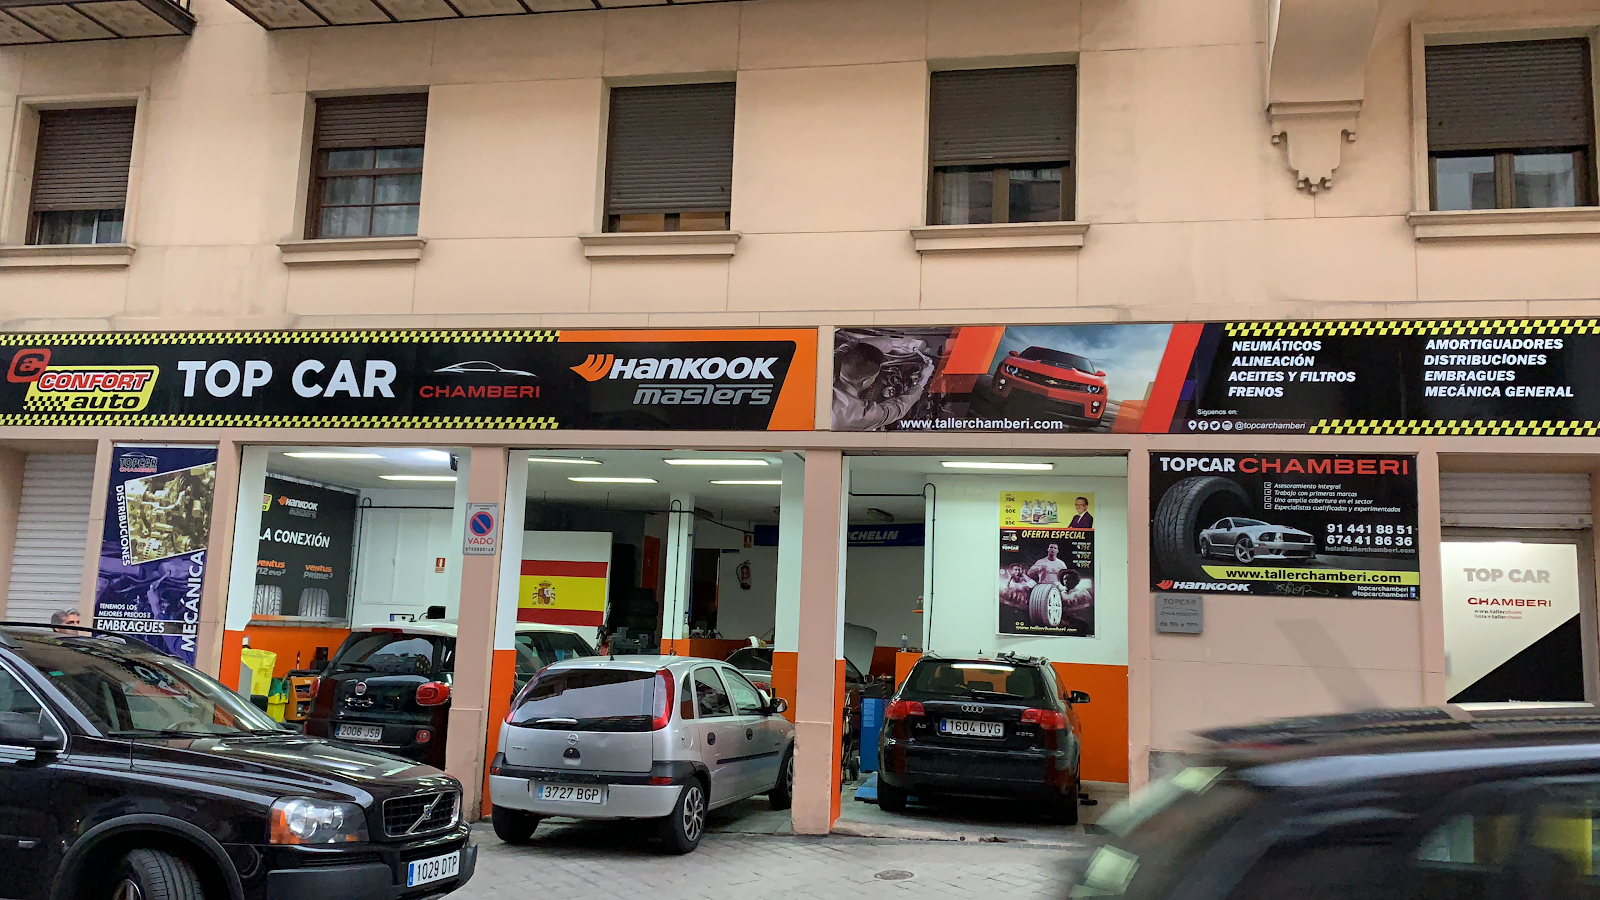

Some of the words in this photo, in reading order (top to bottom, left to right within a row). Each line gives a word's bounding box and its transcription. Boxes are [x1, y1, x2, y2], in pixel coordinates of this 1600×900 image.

[1231, 339, 1322, 352] NEUMÁTICOS
[1425, 338, 1564, 351] AMORTIGUADORES
[1232, 354, 1315, 367] ALINEACIÓN
[1423, 353, 1547, 366] DISTRIBUCIONES
[39, 372, 151, 391] CONFORT
[177, 359, 274, 398] TOP
[291, 359, 398, 398] CAR
[1228, 371, 1284, 383] ACEITES
[1288, 371, 1296, 382] Y
[1299, 371, 1357, 383] FILTROS
[1424, 370, 1516, 382] EMBRAGUES
[419, 385, 541, 399] CHAMBERI
[1228, 386, 1284, 398] FRENOS
[1424, 383, 1502, 398] MECÁNICA
[1504, 385, 1575, 398] GENERAL
[71, 394, 141, 409] auto
[900, 416, 1064, 431] www.tallerchamberi.com
[1234, 421, 1307, 430] @topcarchamberi
[1159, 456, 1236, 473] TOPCAR
[1238, 457, 1410, 475] CHAMBERI
[1274, 489, 1297, 497] Trabajo
[1309, 490, 1336, 498] primeras
[1353, 505, 1401, 513] experimentados
[115, 484, 131, 566] DISTRIBUCIONES
[1326, 523, 1343, 533] 91
[1347, 523, 1372, 534] 441
[1375, 524, 1394, 535] 88
[1396, 525, 1413, 535] 51
[274, 529, 331, 549] CONEXIÓN
[467, 537, 494, 545] VADO
[1021, 530, 1050, 539] OFERTA
[1051, 531, 1086, 540] ESPECIAL
[1326, 534, 1352, 545] 674
[1355, 535, 1371, 545] 41
[1375, 536, 1393, 546] 86
[1395, 537, 1413, 547] 36
[1325, 546, 1416, 554] hola@tallerchamberi.com
[1226, 569, 1402, 583] www.tallerchamberi.com
[1463, 568, 1504, 582] TOP
[1508, 569, 1550, 583] CAR
[1352, 590, 1409, 598] @topcarchamberi
[180, 551, 205, 653] MECÁNICA
[1163, 598, 1197, 606] TOPCAR
[1467, 597, 1552, 607] CHAMBERI
[98, 610, 123, 618] MEJORES
[97, 620, 165, 633] EMBRAGUES
[341, 725, 362, 736] 2006
[364, 727, 380, 738] JSB
[952, 721, 976, 733] 1604
[979, 722, 1001, 734] DVG
[544, 786, 574, 800] 3727
[576, 788, 599, 801] BGP
[417, 861, 440, 881] 1029
[441, 856, 457, 875] DTP
